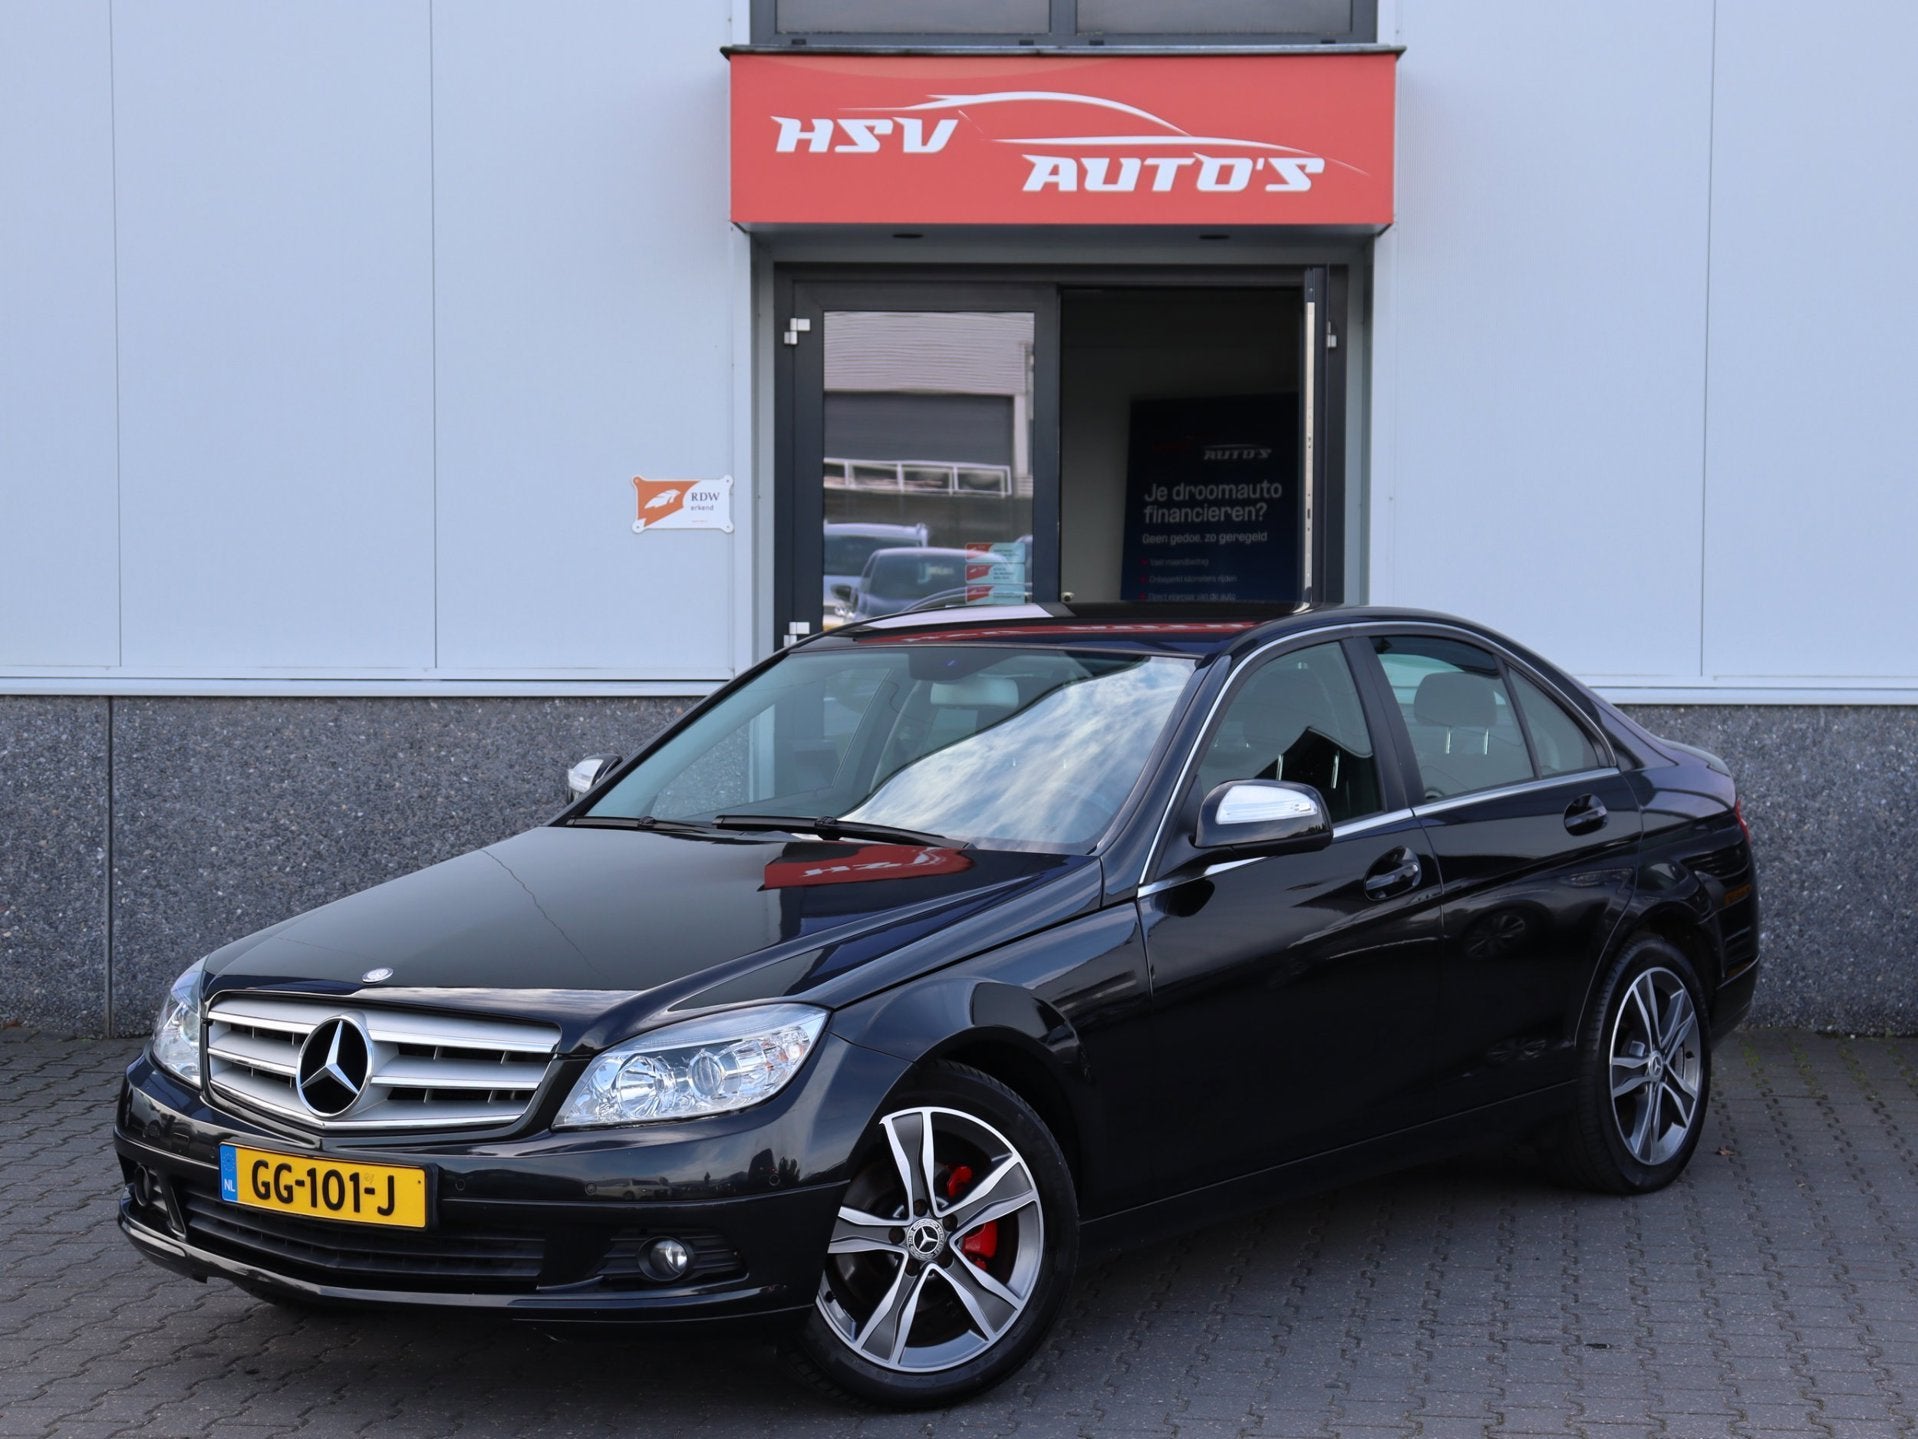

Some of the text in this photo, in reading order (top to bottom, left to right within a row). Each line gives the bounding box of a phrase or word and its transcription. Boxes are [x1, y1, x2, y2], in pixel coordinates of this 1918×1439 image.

[770, 115, 958, 154] HSV
[1021, 152, 1326, 192] AUTO'S
[691, 492, 720, 502] RDW
[1144, 479, 1283, 502] Je droomauto
[1144, 502, 1268, 524] financieren?
[1142, 533, 1168, 544] Geen
[1204, 533, 1217, 543] zo
[1218, 531, 1268, 545] geregeld
[224, 1178, 236, 1192] NL
[251, 1159, 395, 1217] GG-101-J
